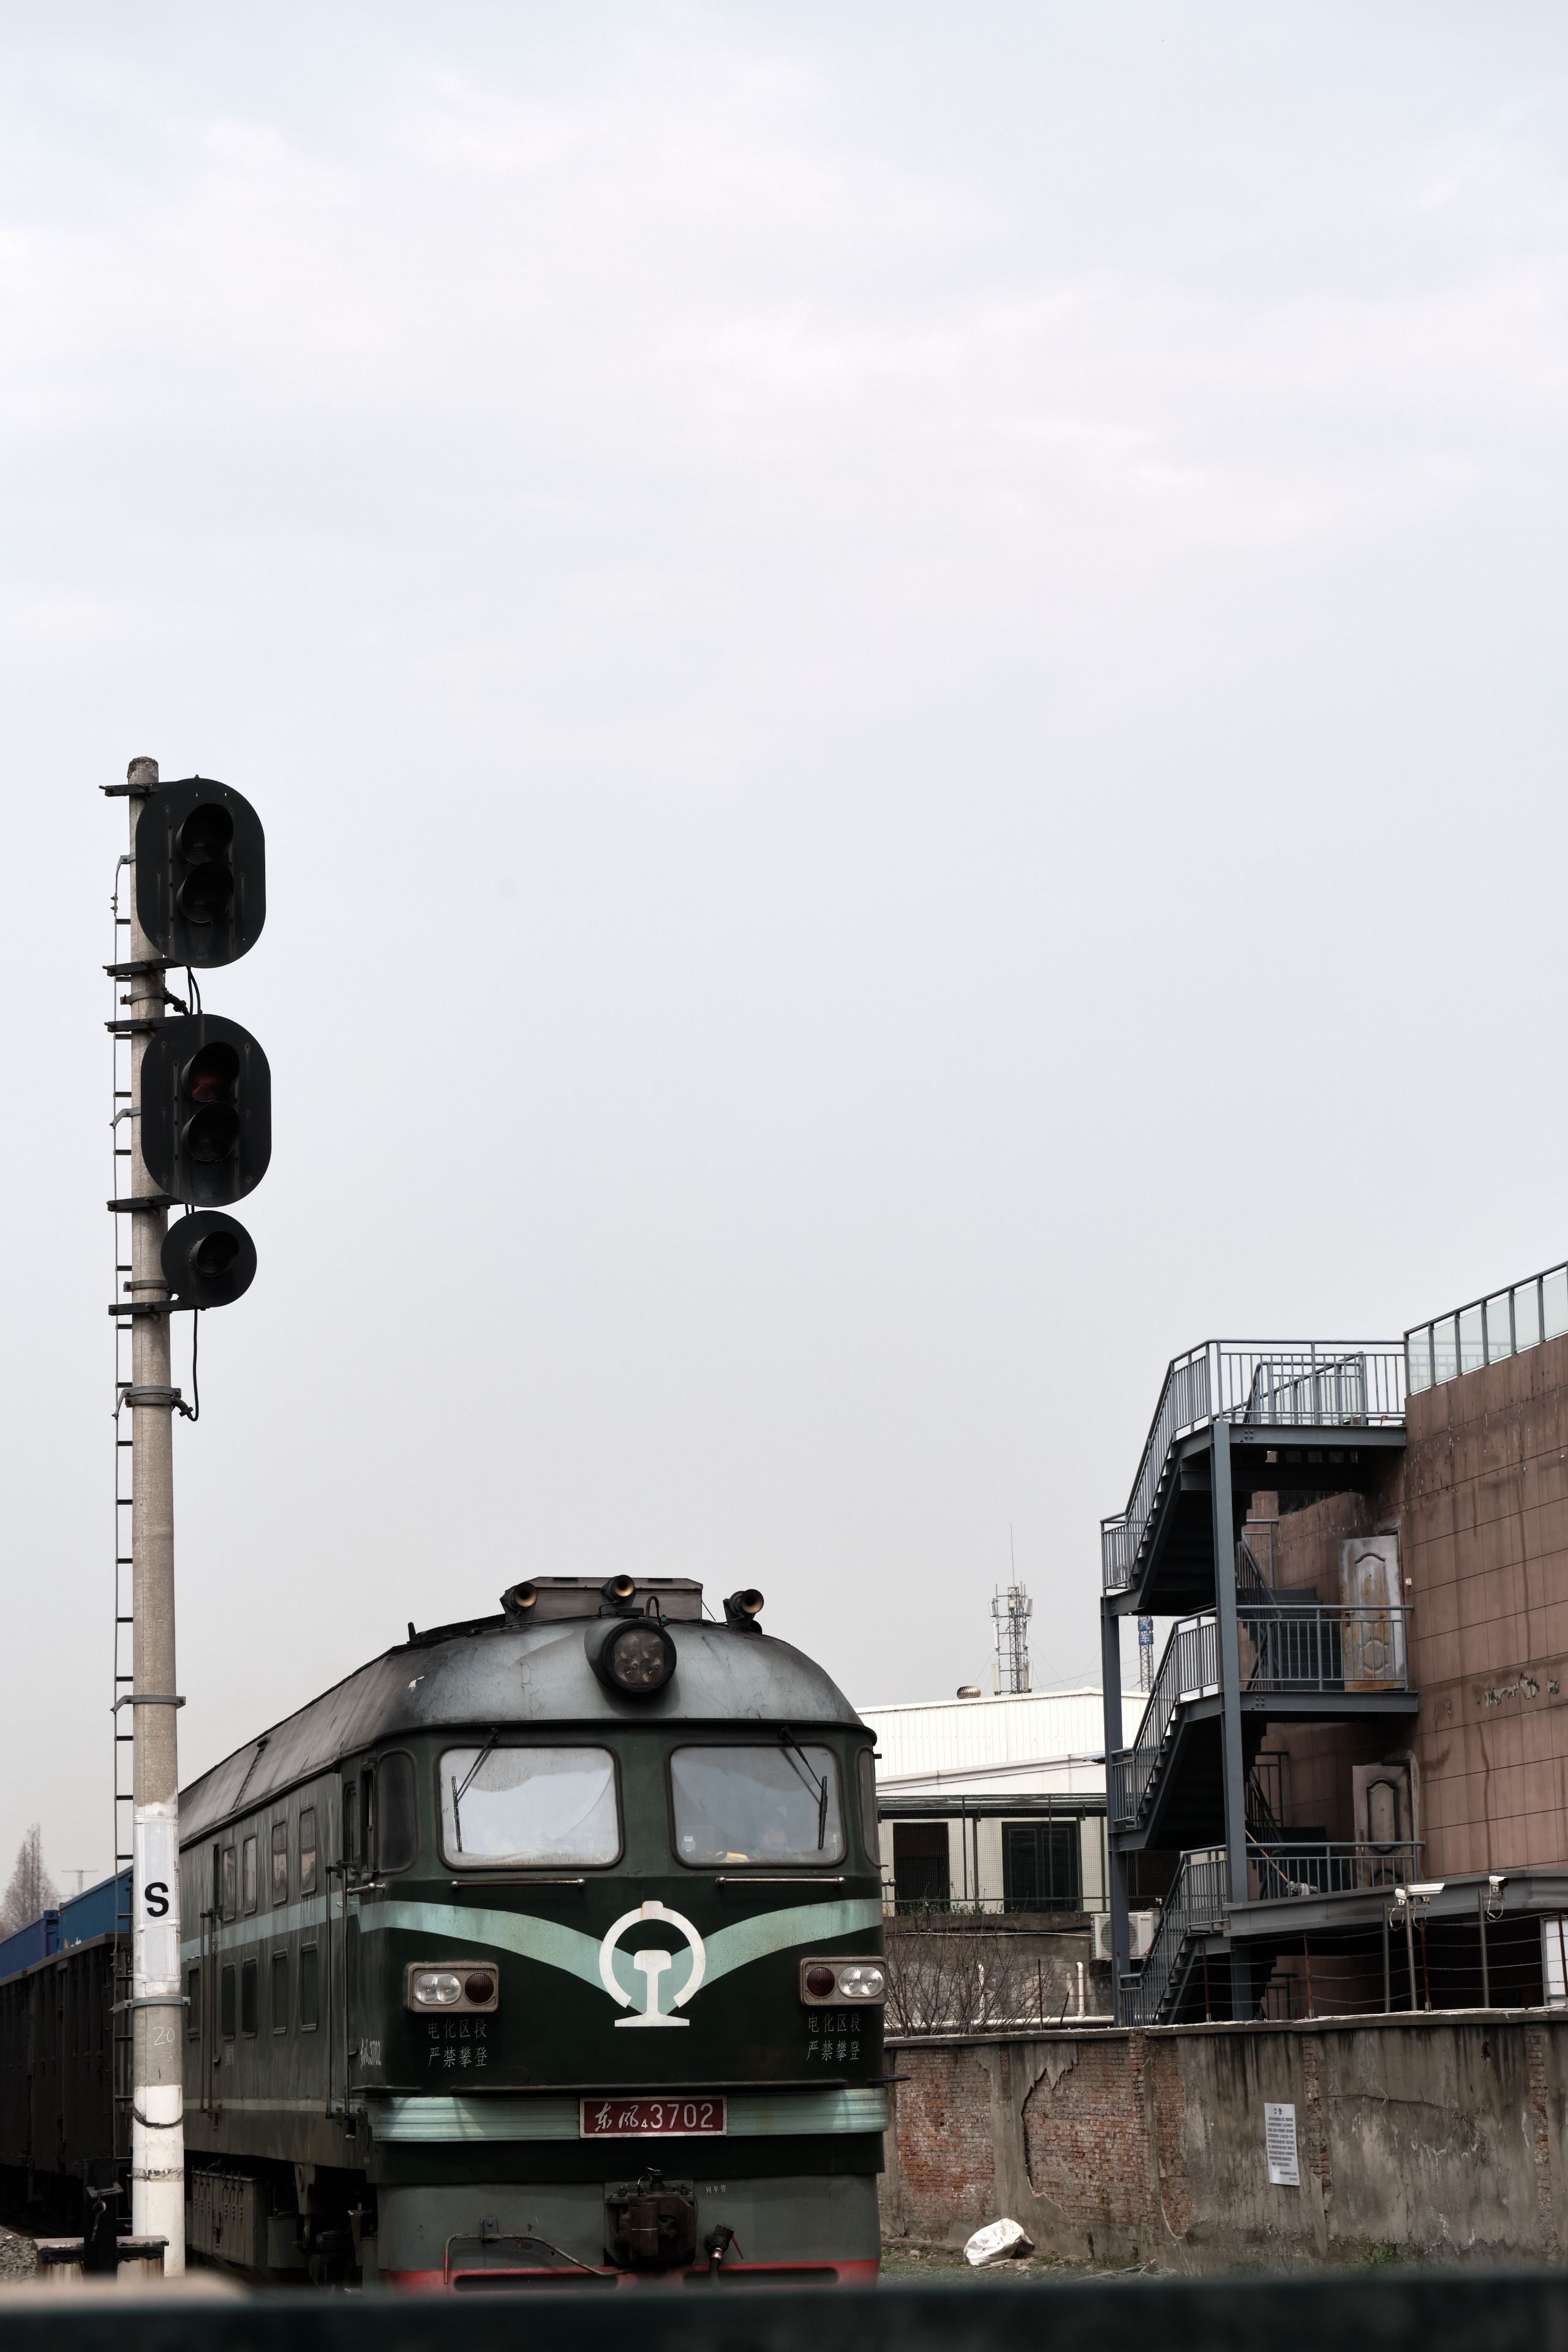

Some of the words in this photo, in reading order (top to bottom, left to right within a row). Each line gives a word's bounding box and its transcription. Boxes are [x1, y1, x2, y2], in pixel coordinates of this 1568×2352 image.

[145, 1882, 170, 1917] S
[428, 2019, 488, 2039] 电化区段
[809, 2013, 861, 2033] 电化区段
[153, 2026, 175, 2046] 20
[428, 2046, 488, 2068] 严禁攀登
[806, 2040, 860, 2062] 严禁攀登
[705, 2185, 726, 2194] 列车管
